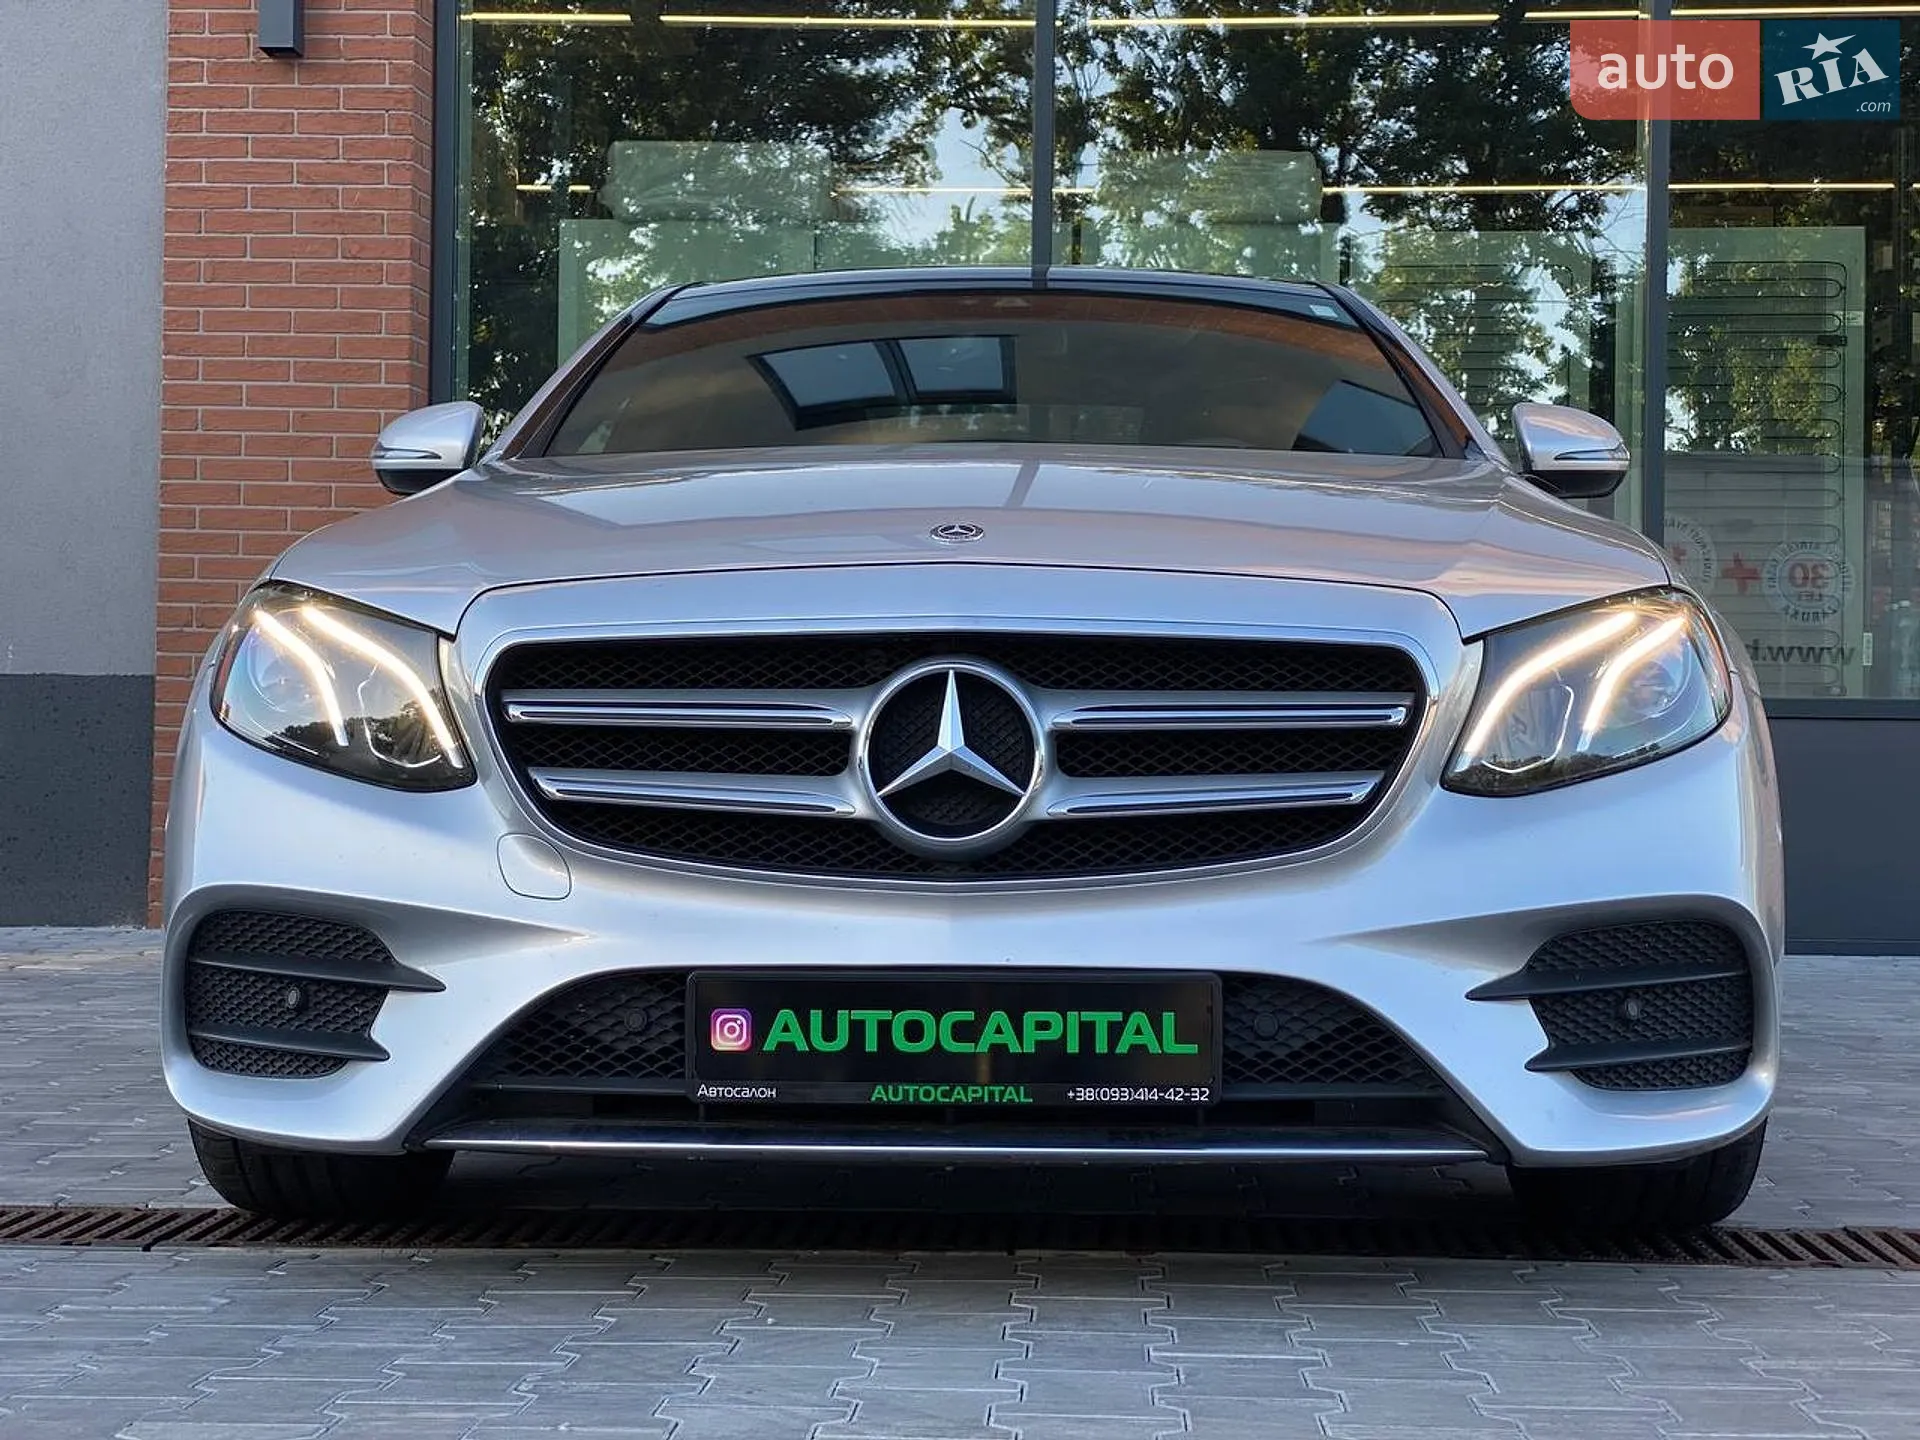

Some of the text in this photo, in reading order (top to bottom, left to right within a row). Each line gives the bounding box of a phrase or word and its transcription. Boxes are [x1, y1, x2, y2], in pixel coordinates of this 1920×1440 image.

[763, 1009, 1198, 1054] AUTOCAPITAL
[697, 1084, 777, 1099] Автосалон
[870, 1085, 1033, 1103] AUTOCAPITAL
[1067, 1087, 1211, 1101] +38(093)414-42-32
